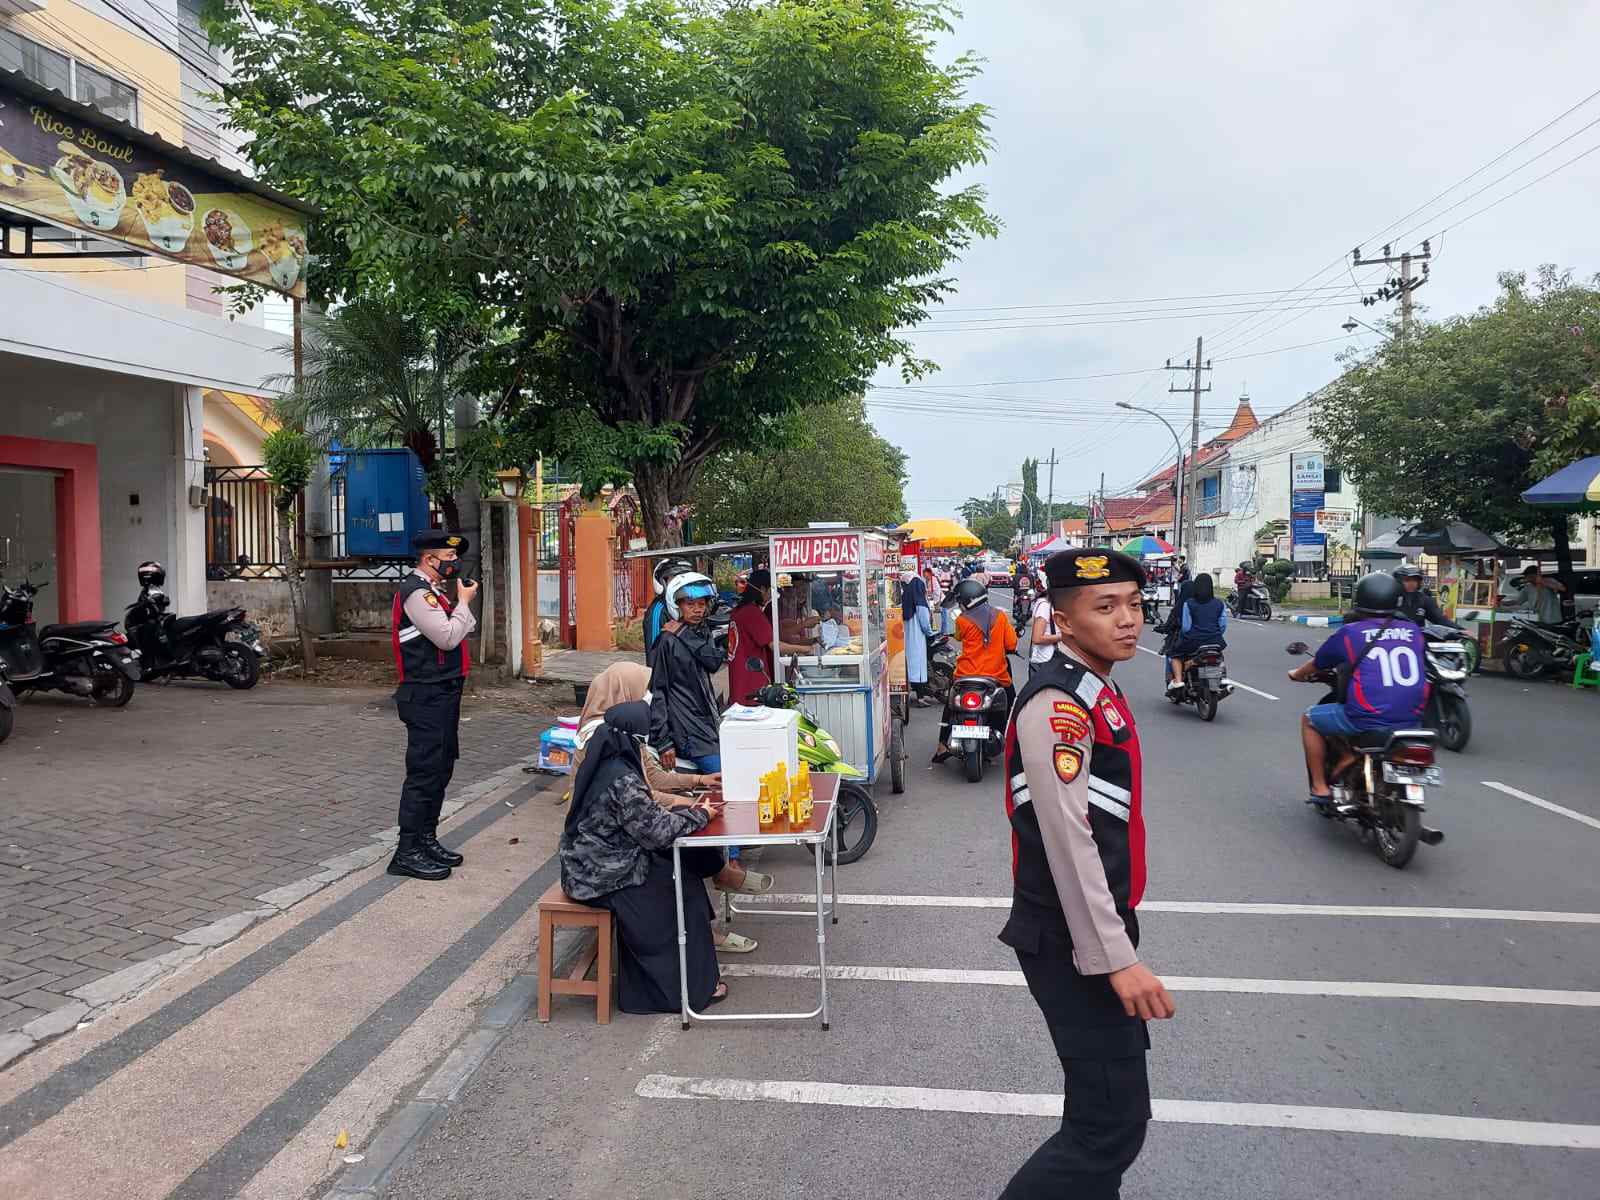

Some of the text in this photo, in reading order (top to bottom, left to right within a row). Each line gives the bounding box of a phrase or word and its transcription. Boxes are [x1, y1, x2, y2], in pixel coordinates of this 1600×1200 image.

[30, 106, 75, 139] Rice
[79, 128, 134, 163] Bowl
[774, 537, 859, 567] TAHU PEDAS
[1366, 646, 1420, 687] 10
